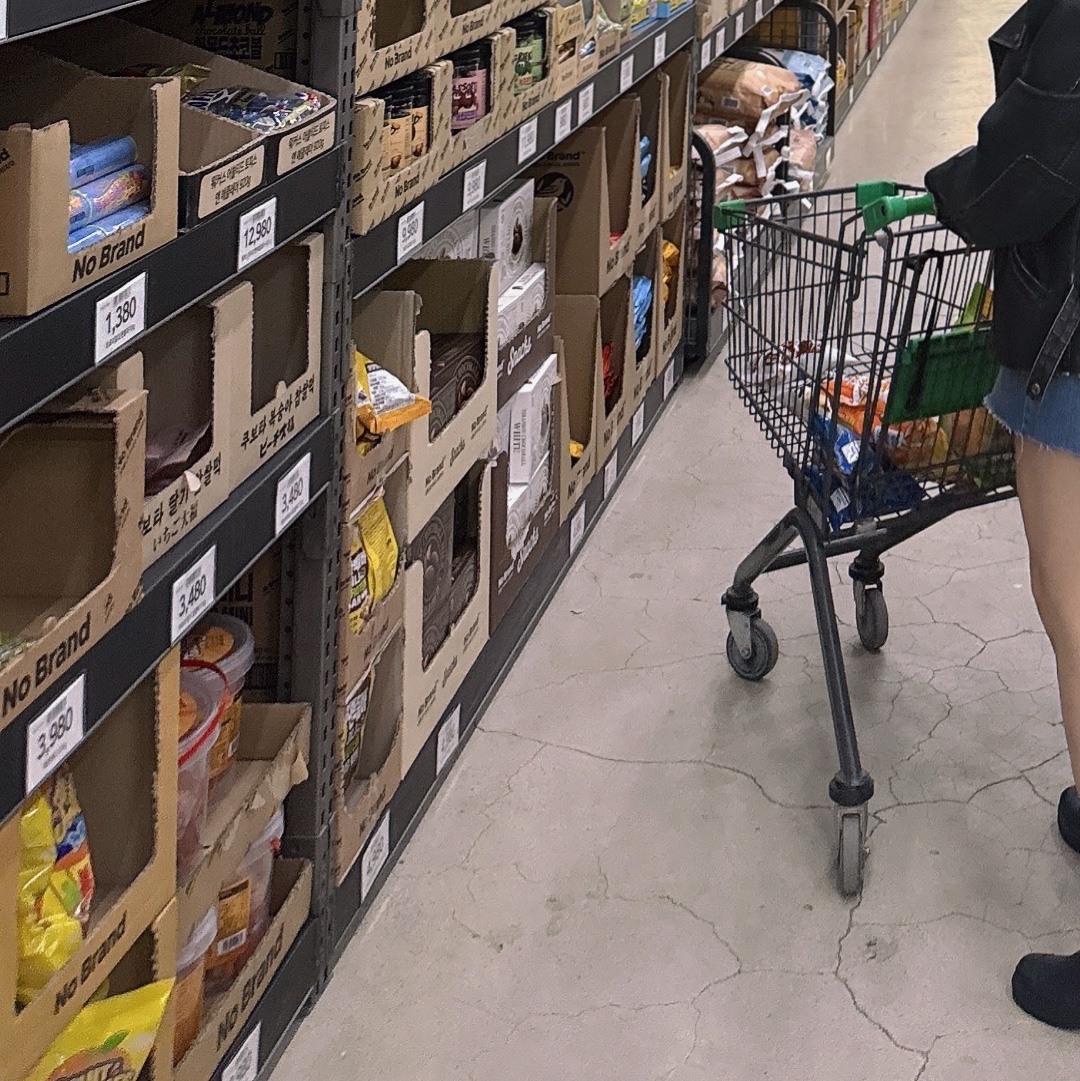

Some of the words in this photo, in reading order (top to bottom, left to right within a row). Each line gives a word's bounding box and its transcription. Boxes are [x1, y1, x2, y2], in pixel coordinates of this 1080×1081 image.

[461, 22, 470, 35] No
[470, 18, 484, 31] Brand
[385, 54, 395, 70] No
[394, 45, 412, 66] Brand
[394, 182, 405, 199] No
[405, 173, 420, 193] Brand
[72, 256, 97, 283] No
[98, 223, 146, 271] Brand
[243, 216, 272, 247] 12,980
[105, 295, 138, 335] 1,380
[240, 416, 267, 450] 쿠보타
[267, 392, 293, 429] 복숭아
[178, 573, 207, 618] 3,480
[1, 672, 32, 719] No
[35, 610, 93, 689] Brand
[36, 705, 74, 760] 3,980
[53, 976, 79, 1016] No
[79, 910, 128, 986] Brand
[215, 1003, 240, 1052] No
[240, 921, 286, 1012] Brand
